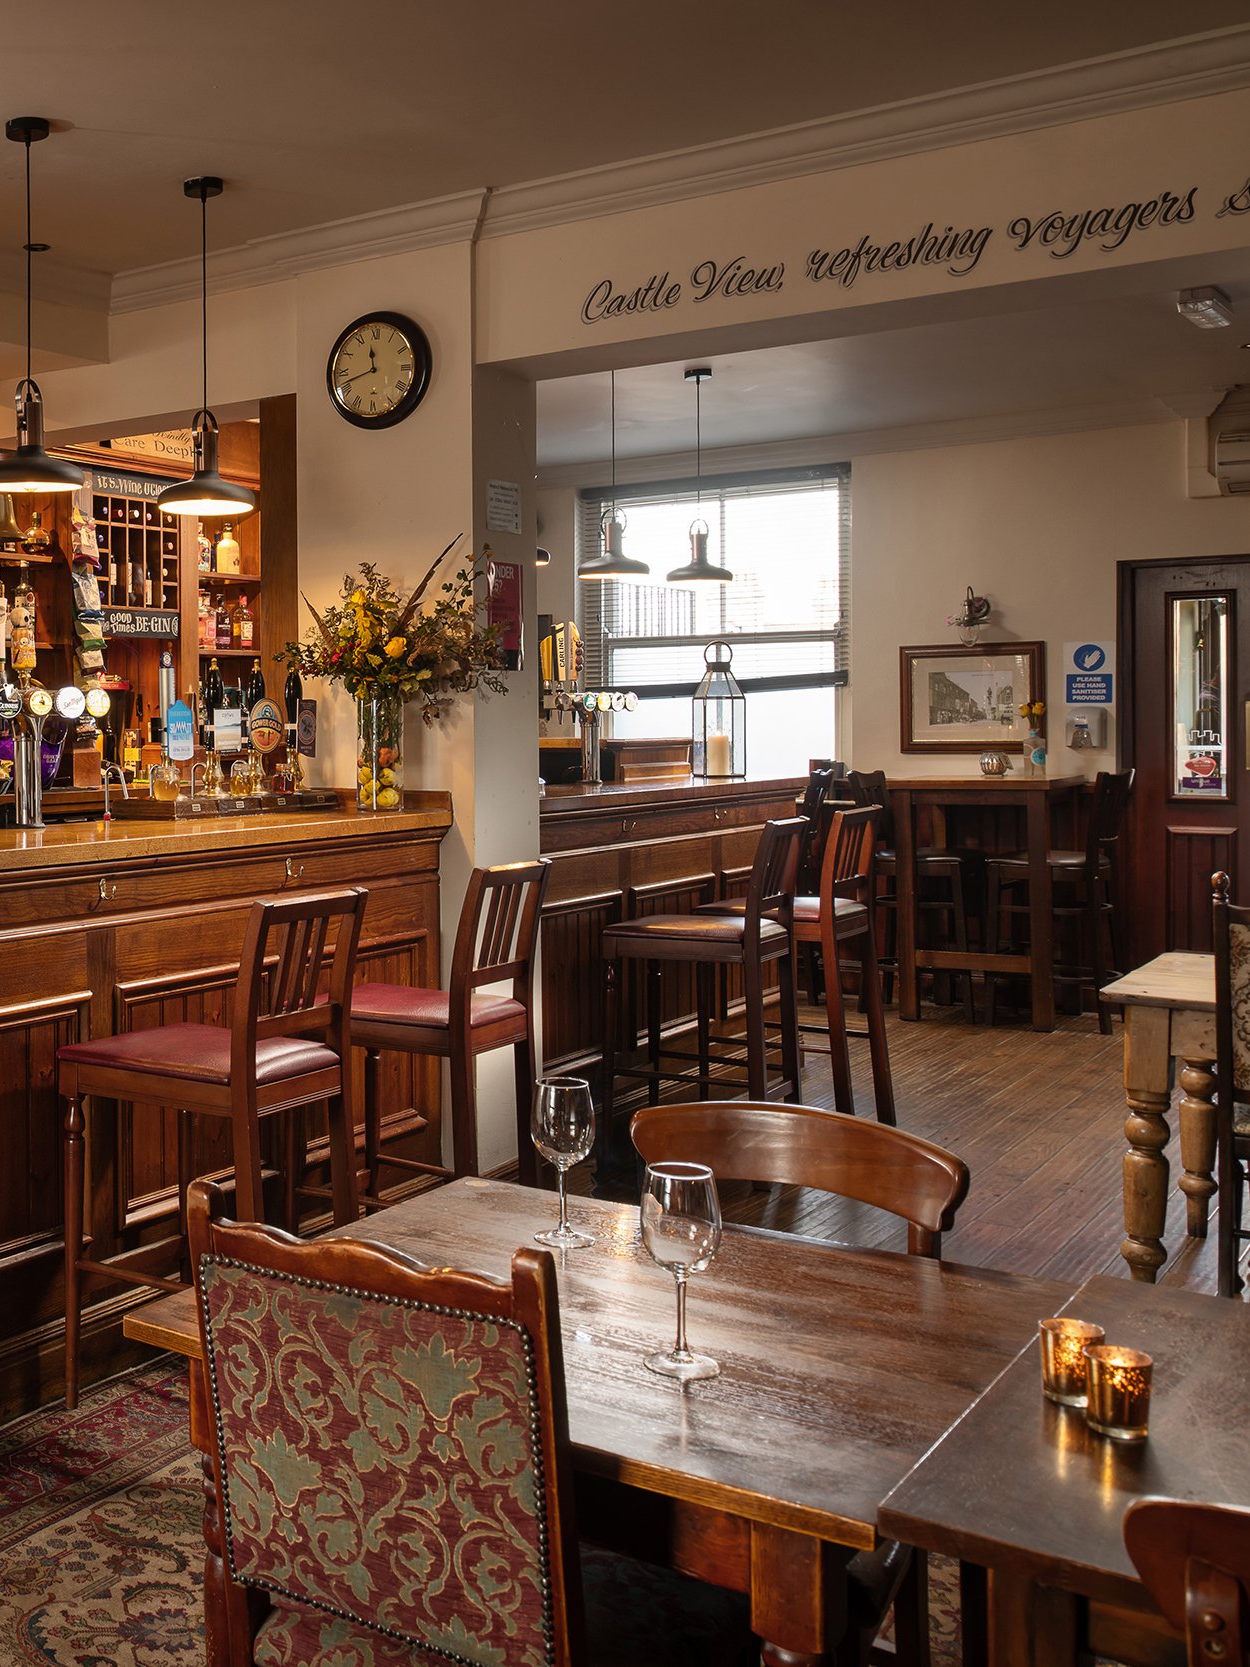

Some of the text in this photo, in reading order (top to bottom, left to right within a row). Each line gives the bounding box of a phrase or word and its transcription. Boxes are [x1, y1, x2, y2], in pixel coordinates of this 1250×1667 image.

[582, 271, 681, 324] Castle
[691, 256, 785, 303] View,
[806, 222, 994, 289] refreshing
[113, 438, 194, 458] Care Deepl
[118, 478, 143, 495] Wine
[110, 612, 132, 623] GOOD
[111, 621, 136, 634] Times
[170, 721, 192, 734] SUMMIT
[251, 719, 282, 732] GOWER GOLD
